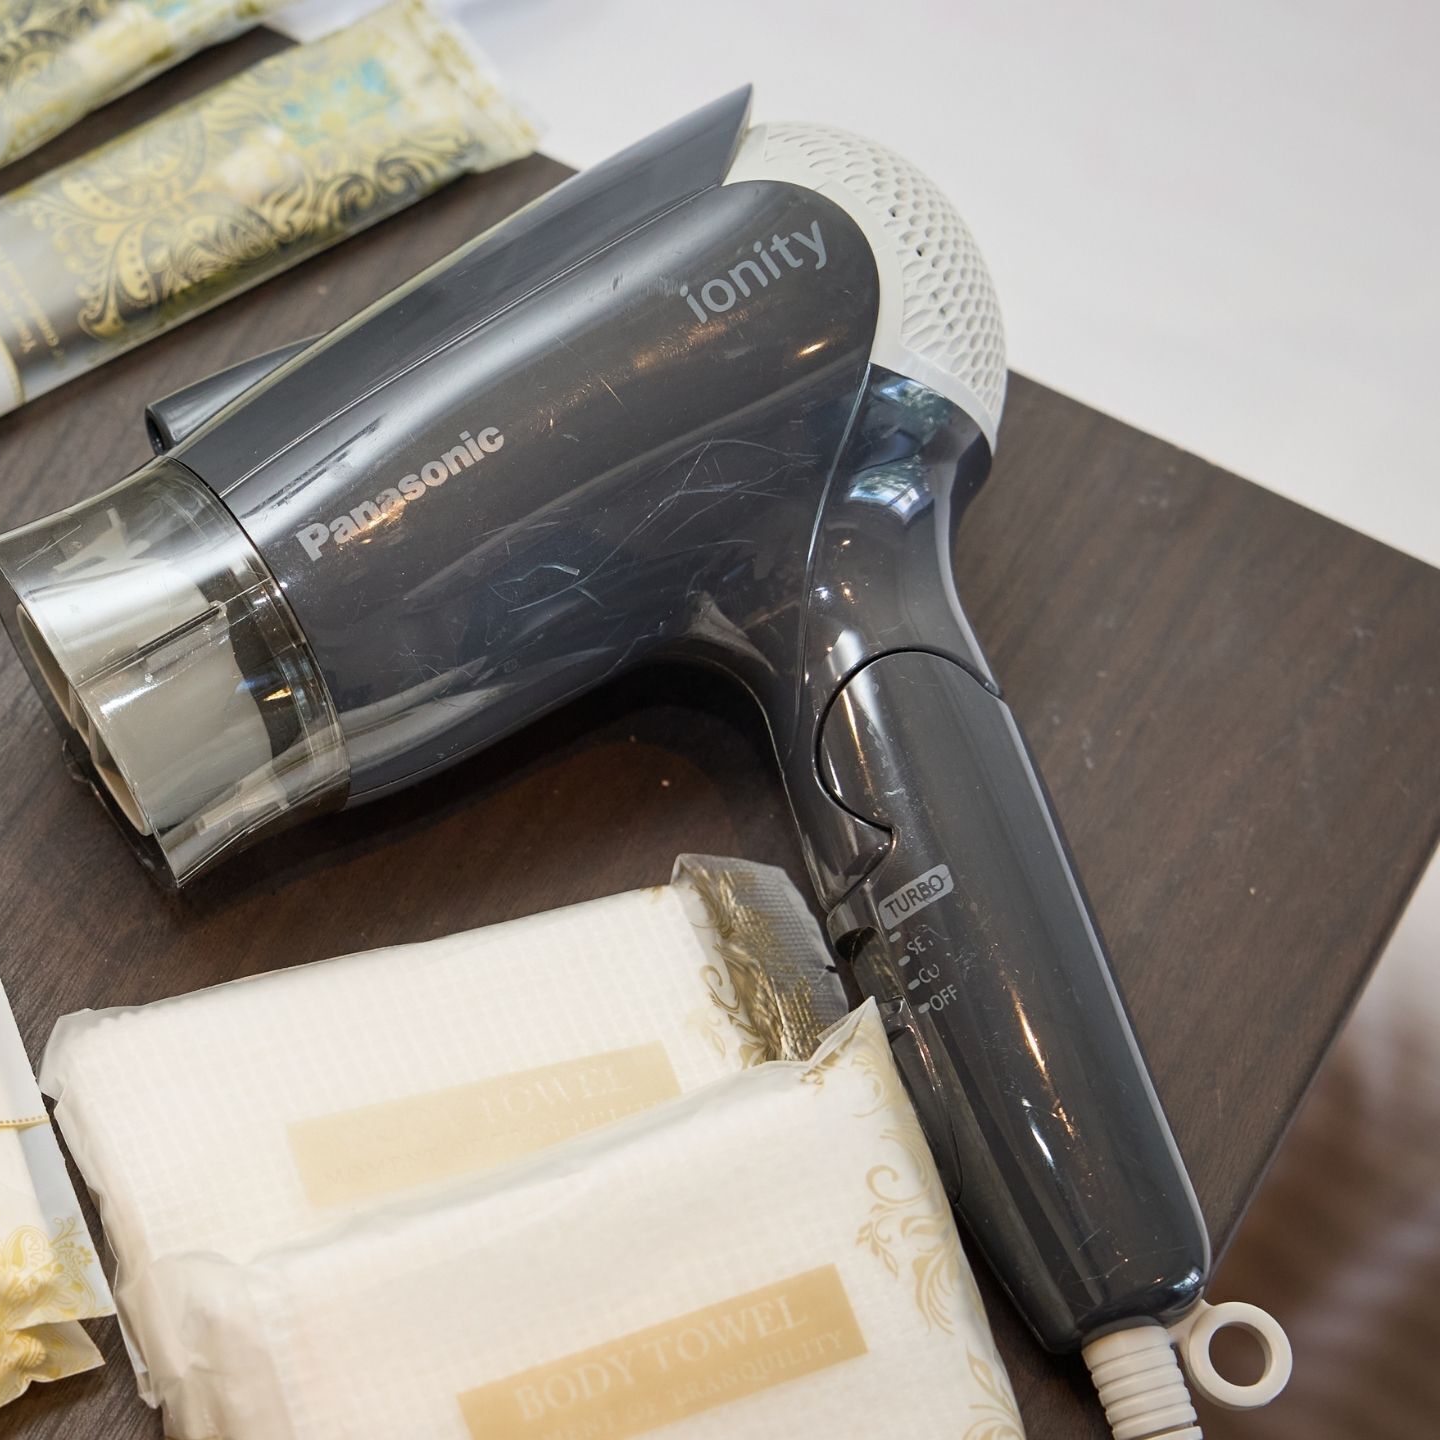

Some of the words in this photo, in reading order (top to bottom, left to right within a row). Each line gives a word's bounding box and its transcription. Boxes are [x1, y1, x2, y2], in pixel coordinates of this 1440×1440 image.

[680, 220, 827, 324] ionity
[295, 426, 505, 562] Panasonic
[884, 874, 945, 918] TURBO
[929, 984, 957, 1011] OFF
[512, 1347, 637, 1422] BODY
[642, 1294, 809, 1373] TOWEL
